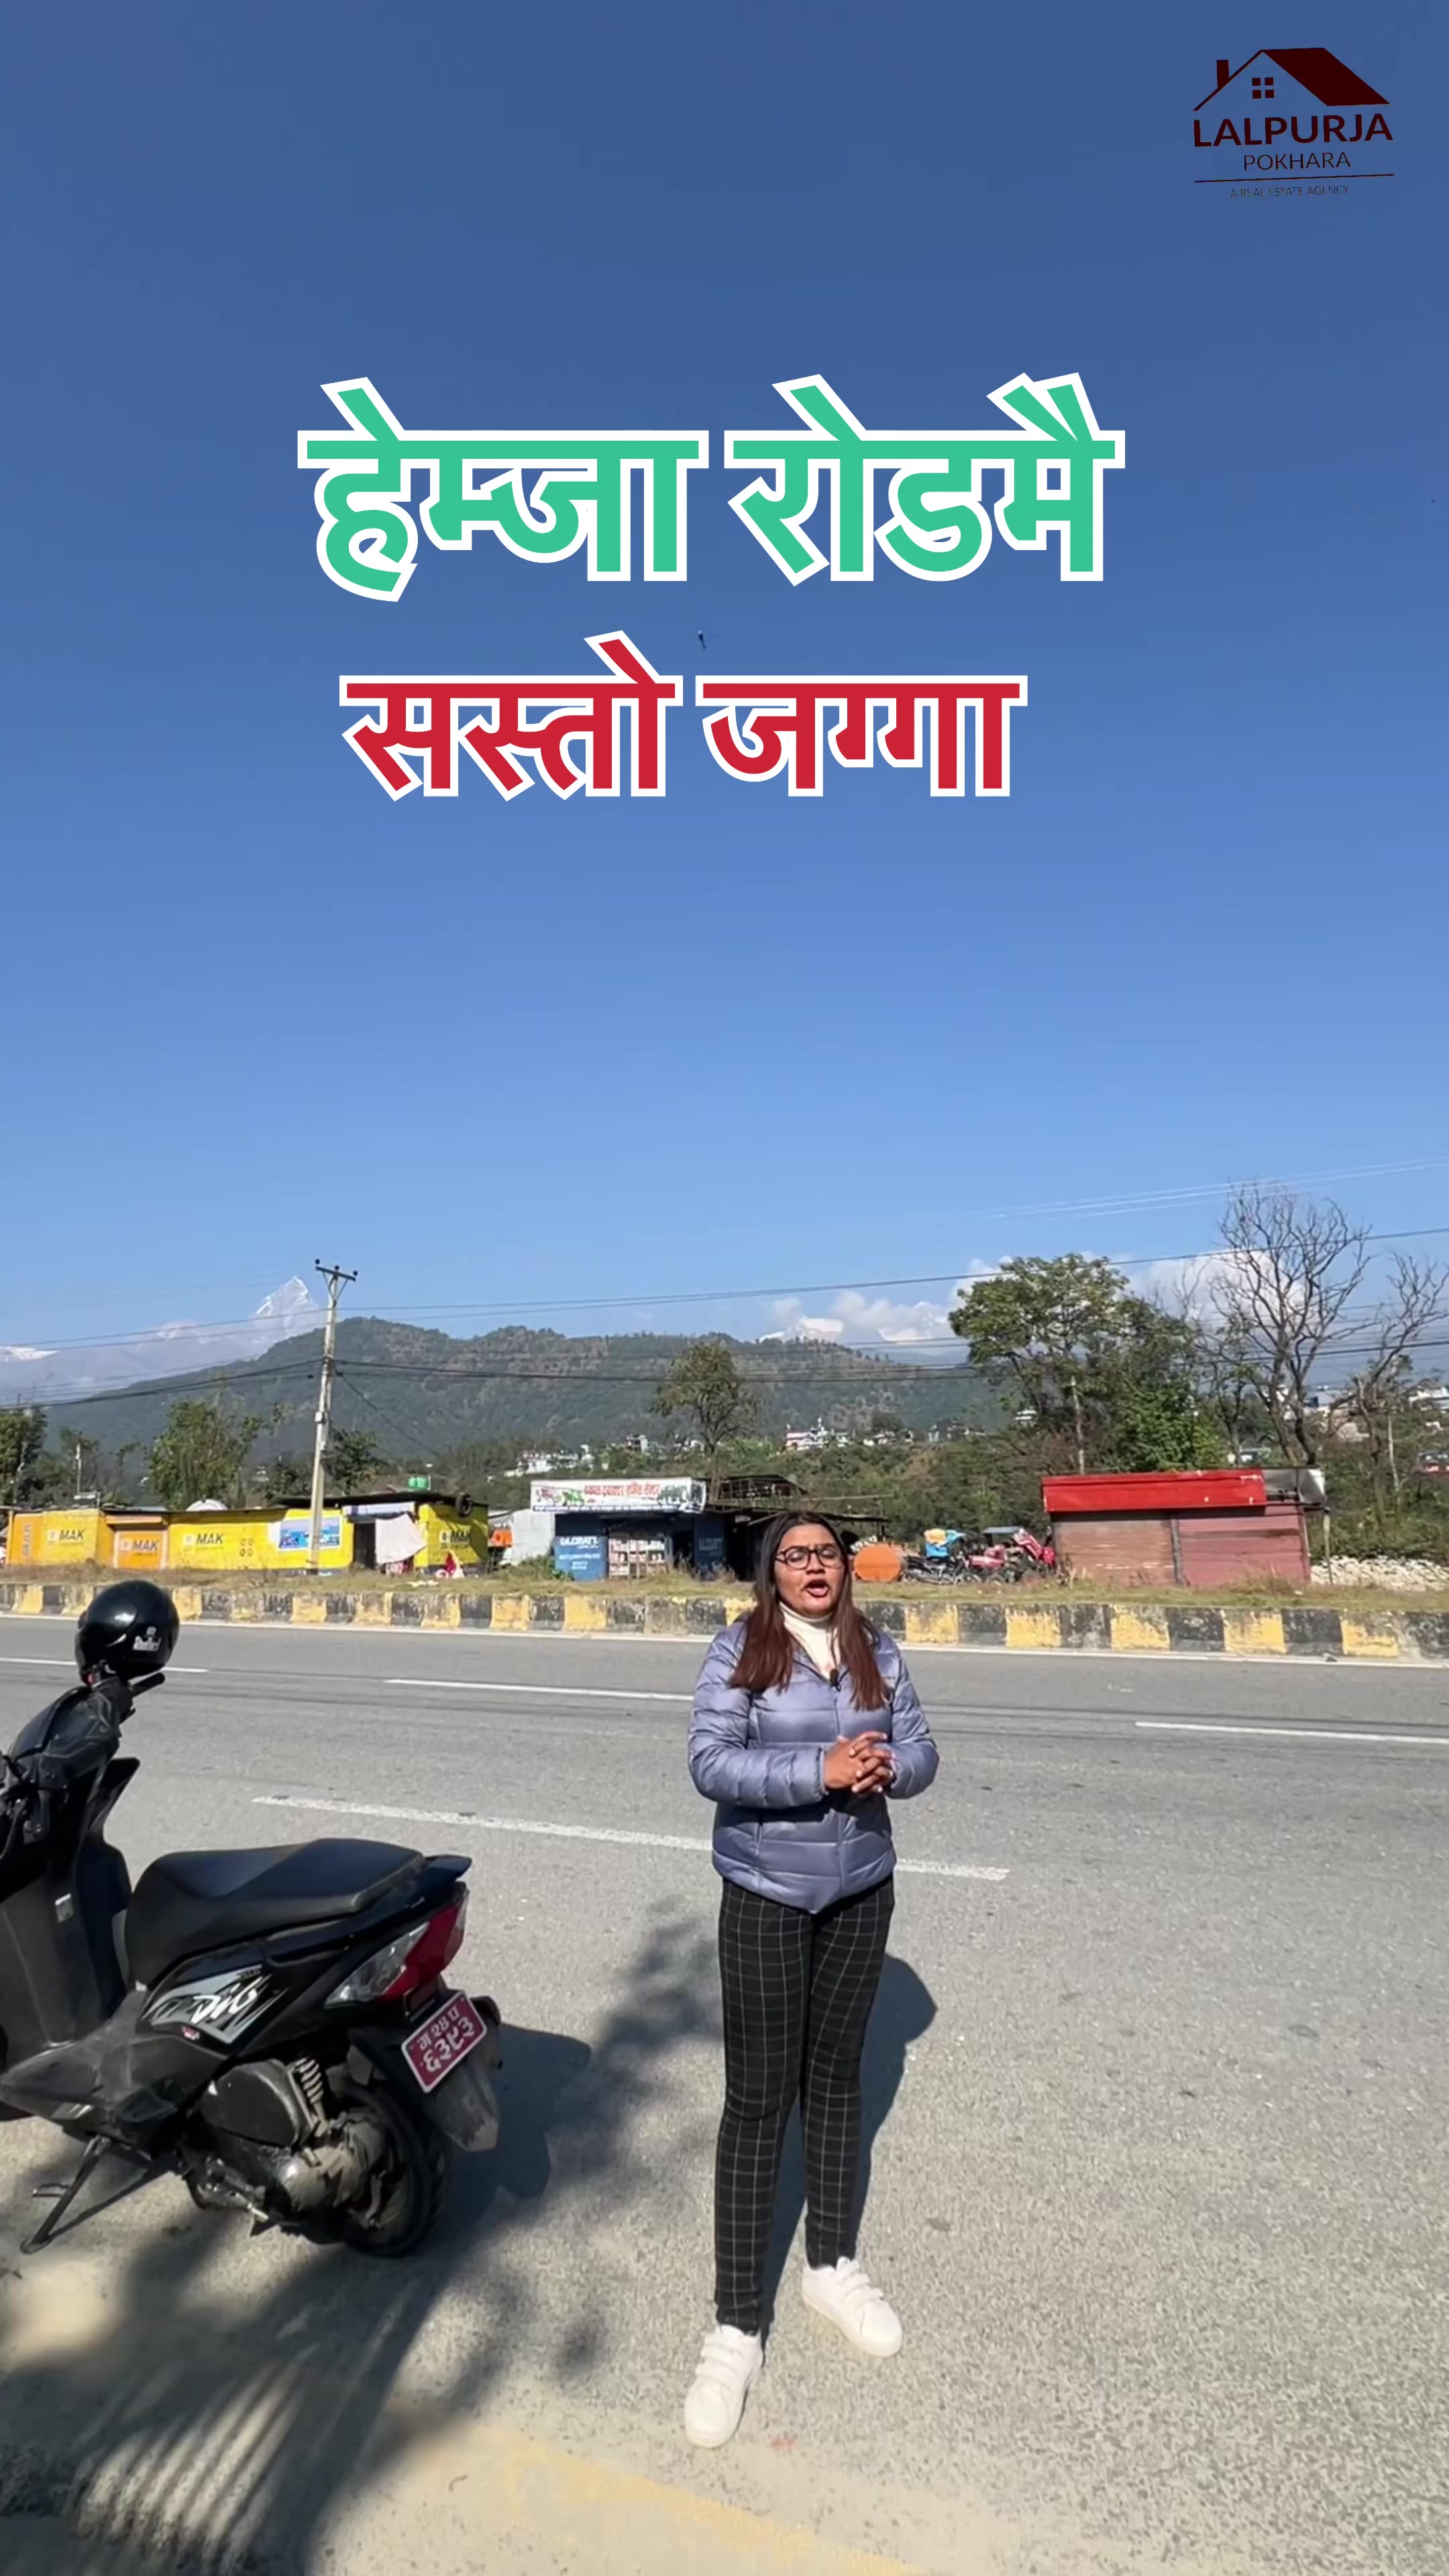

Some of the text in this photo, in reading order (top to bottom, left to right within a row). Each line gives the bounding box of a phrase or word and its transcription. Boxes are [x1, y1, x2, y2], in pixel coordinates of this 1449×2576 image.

[59, 1529, 85, 1541] MAK
[195, 1533, 224, 1545] MAK
[131, 1540, 159, 1551] MAK
[417, 2032, 432, 2050] ग
